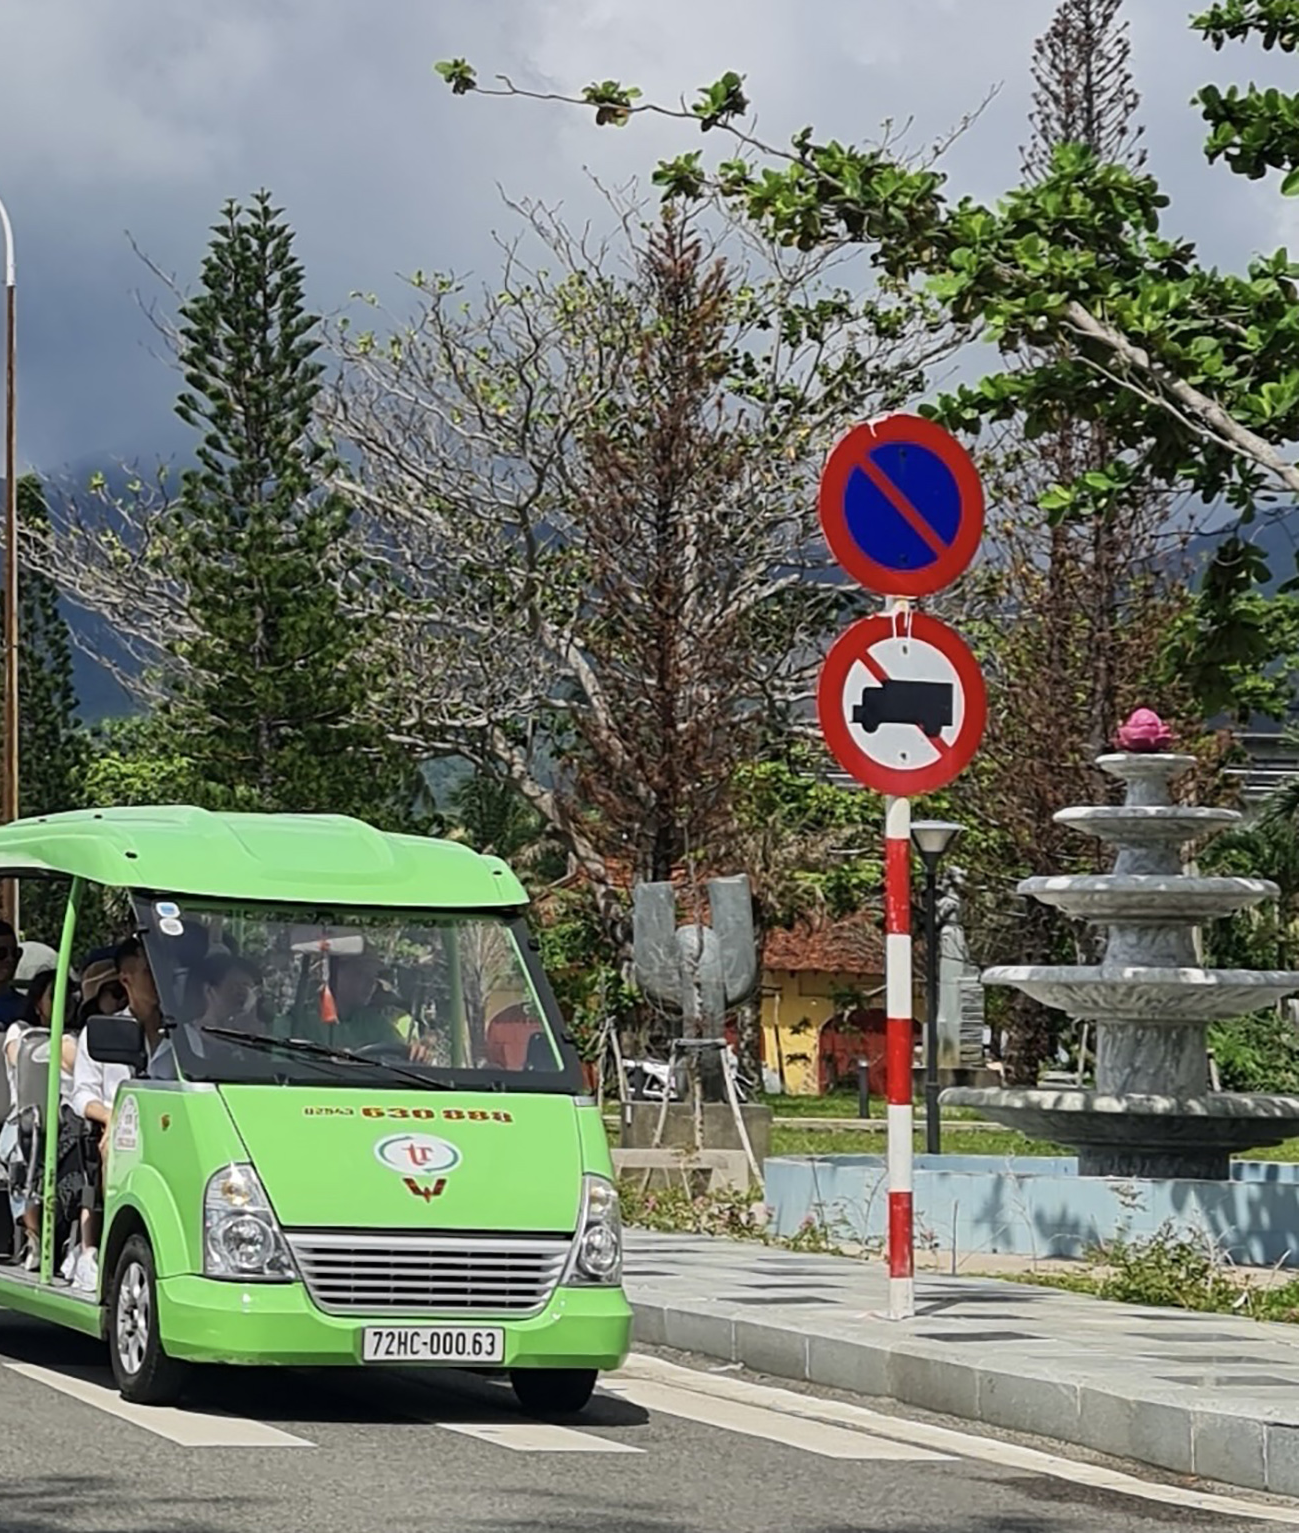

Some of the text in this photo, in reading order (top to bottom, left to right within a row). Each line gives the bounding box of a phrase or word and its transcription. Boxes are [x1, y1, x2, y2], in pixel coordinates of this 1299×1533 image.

[361, 1106, 435, 1119] 630
[442, 1109, 514, 1123] 888
[372, 1330, 496, 1356] 72HC-000.63
